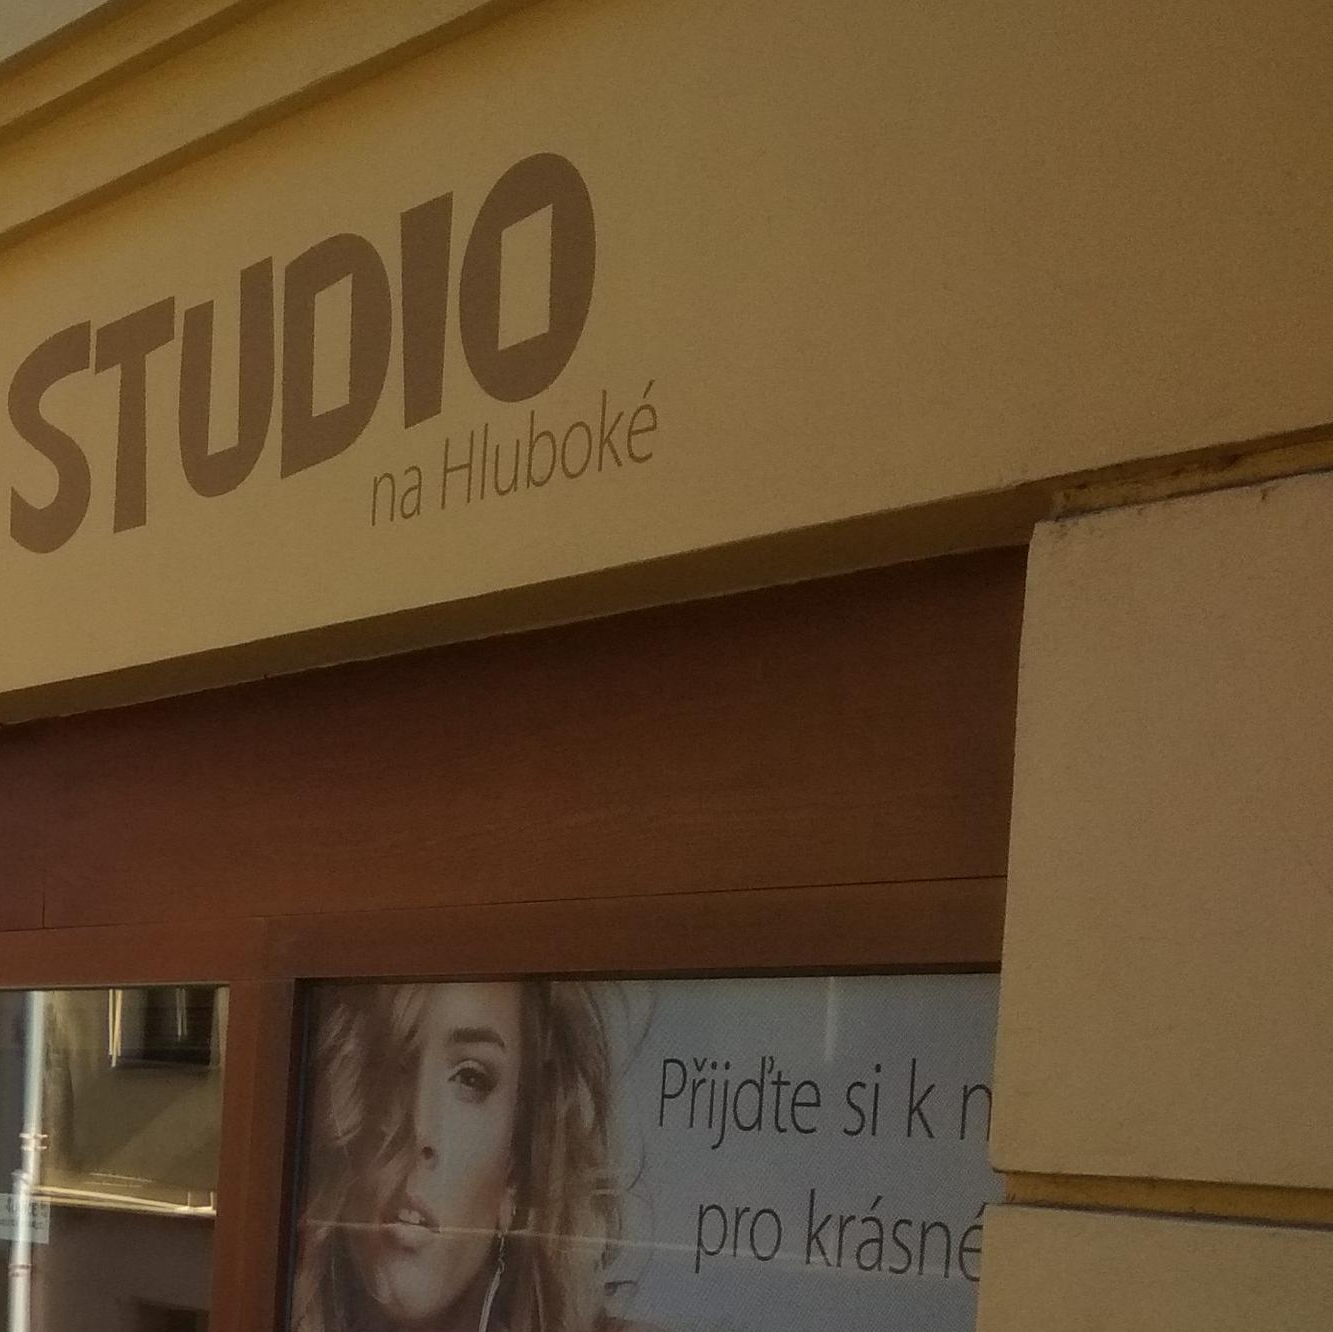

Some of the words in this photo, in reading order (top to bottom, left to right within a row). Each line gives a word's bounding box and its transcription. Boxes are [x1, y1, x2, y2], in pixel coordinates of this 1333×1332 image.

[7, 152, 597, 555] STUDIO
[370, 459, 423, 526] na
[441, 380, 660, 510] Hluboké
[658, 1055, 822, 1151] Přijďte
[842, 1063, 882, 1137] si
[906, 1057, 936, 1139] k
[694, 1203, 783, 1275] pro
[805, 1187, 987, 1282] krásné
